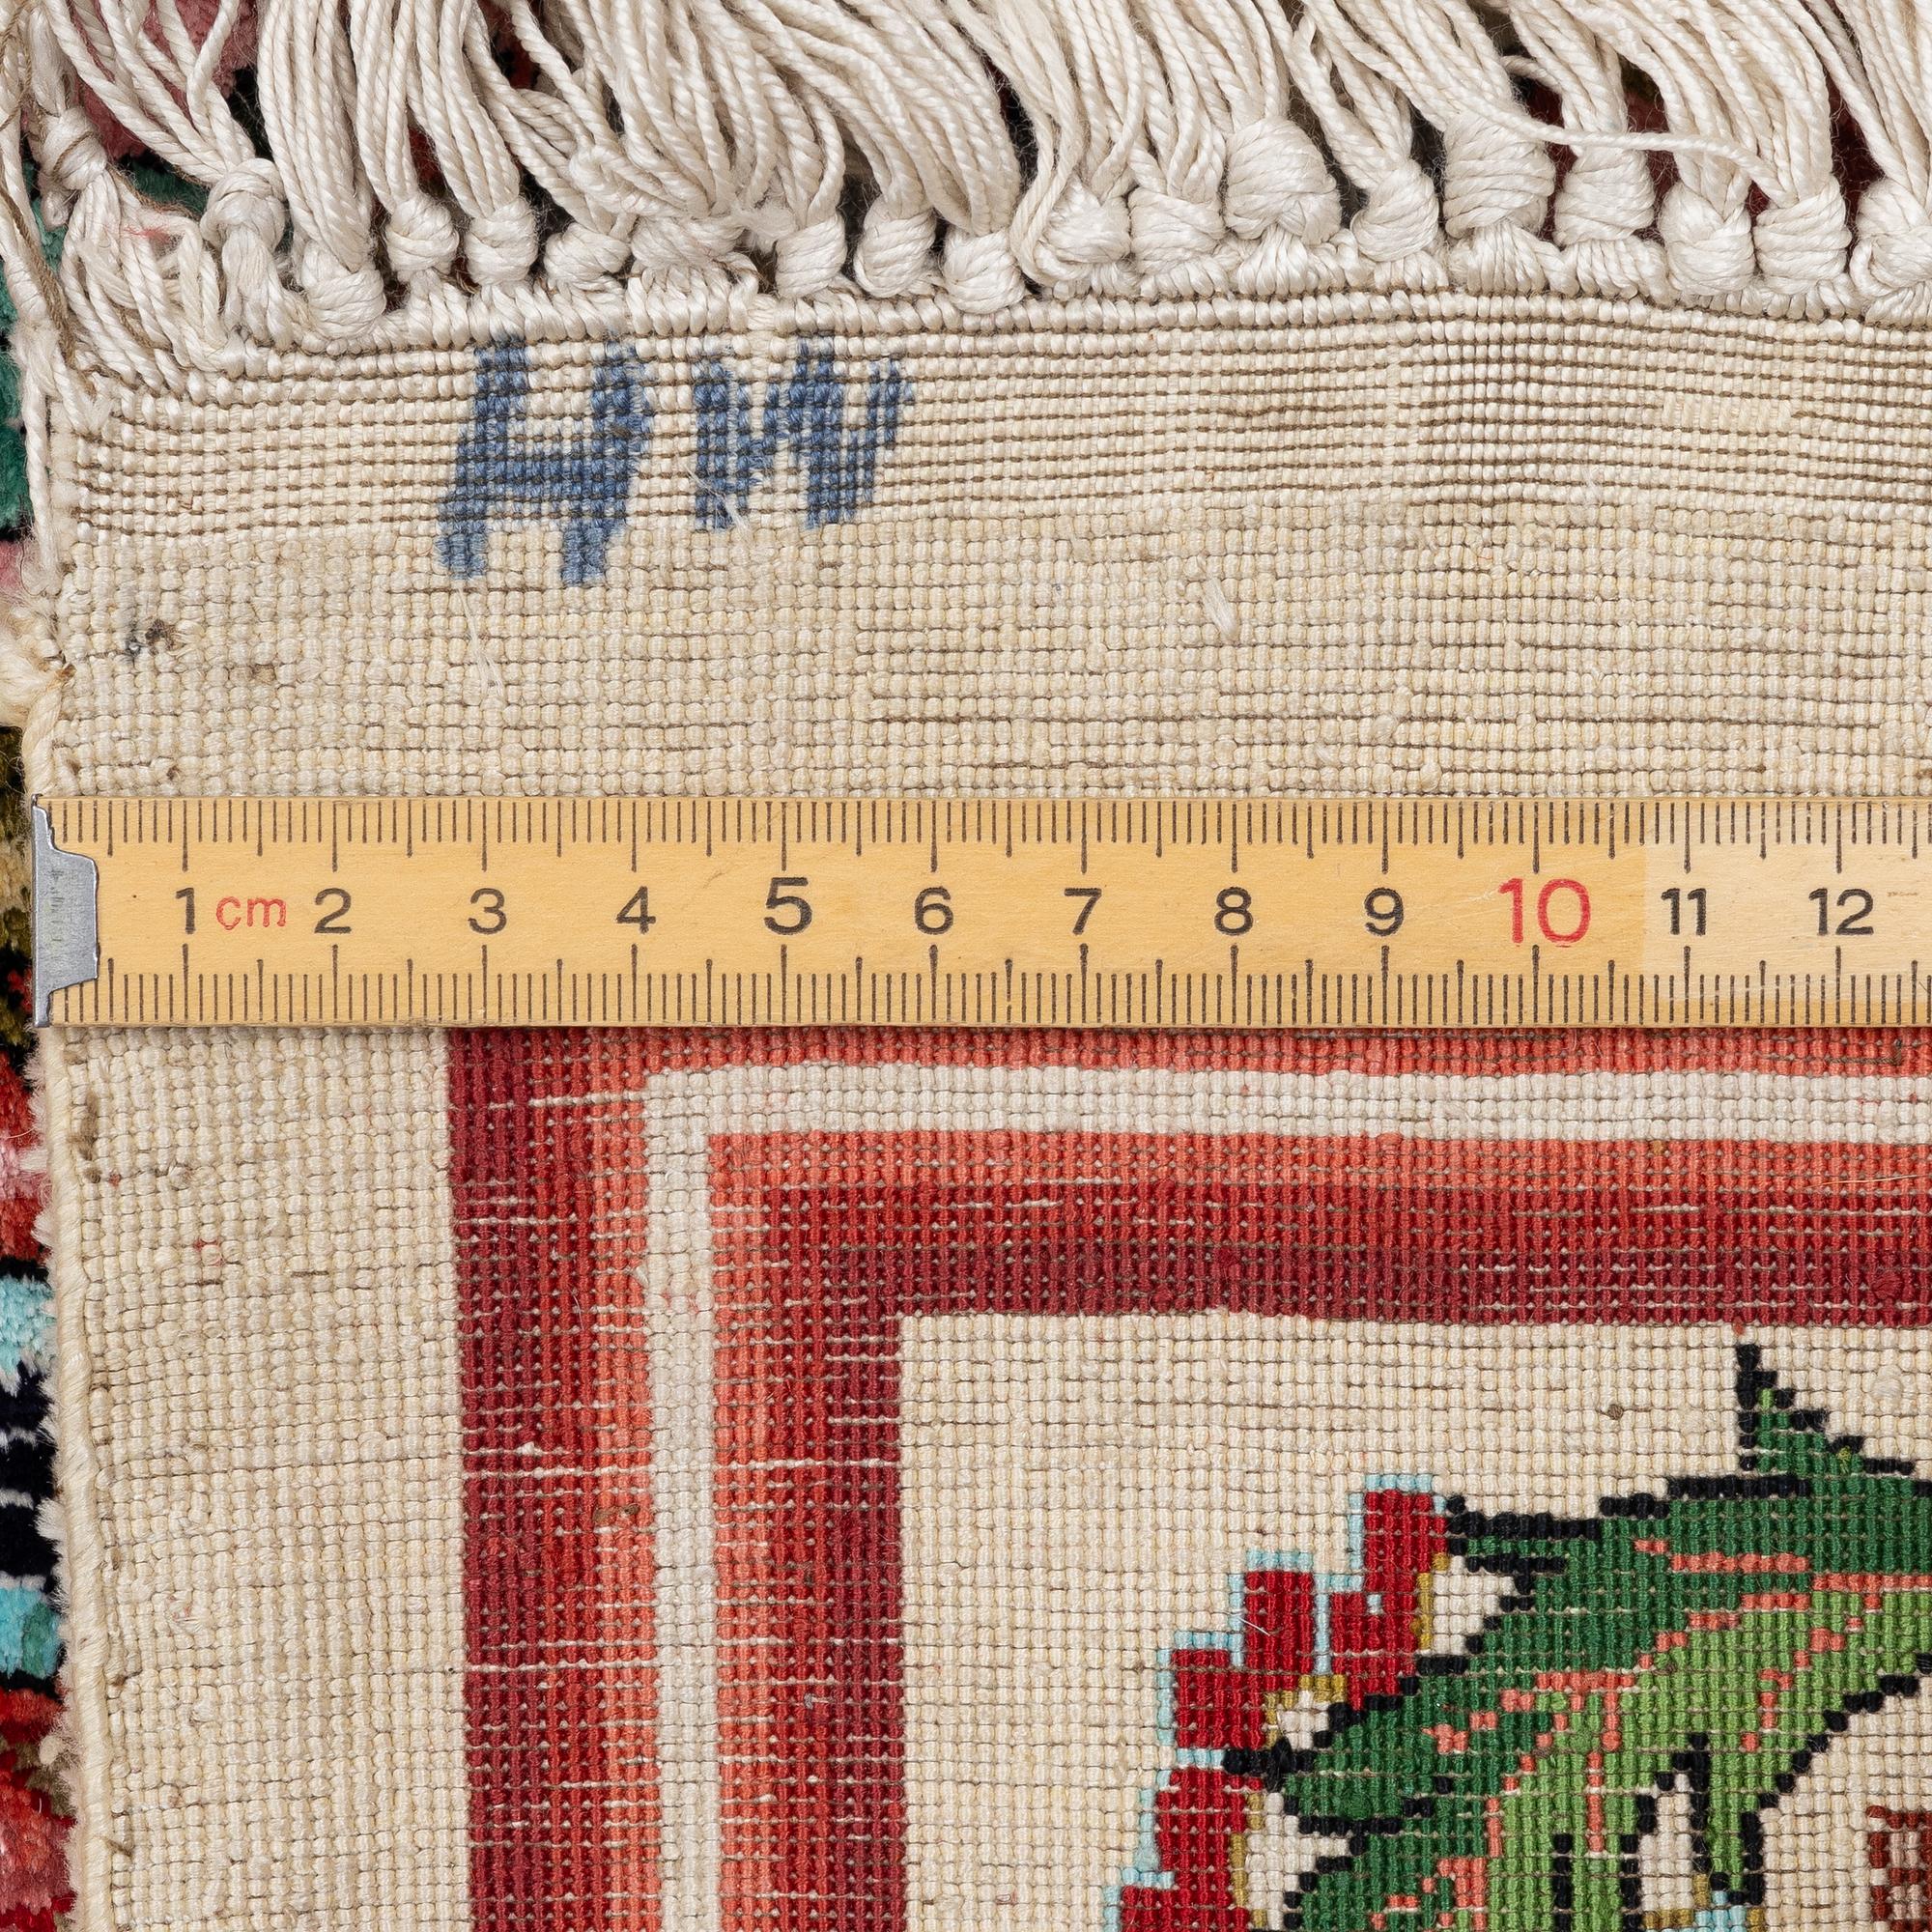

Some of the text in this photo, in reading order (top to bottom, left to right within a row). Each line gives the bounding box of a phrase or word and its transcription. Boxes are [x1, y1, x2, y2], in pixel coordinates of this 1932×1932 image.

[176, 876, 1875, 946] 1 cm 2 3 4 5 6 7 8 9 10 11 12
